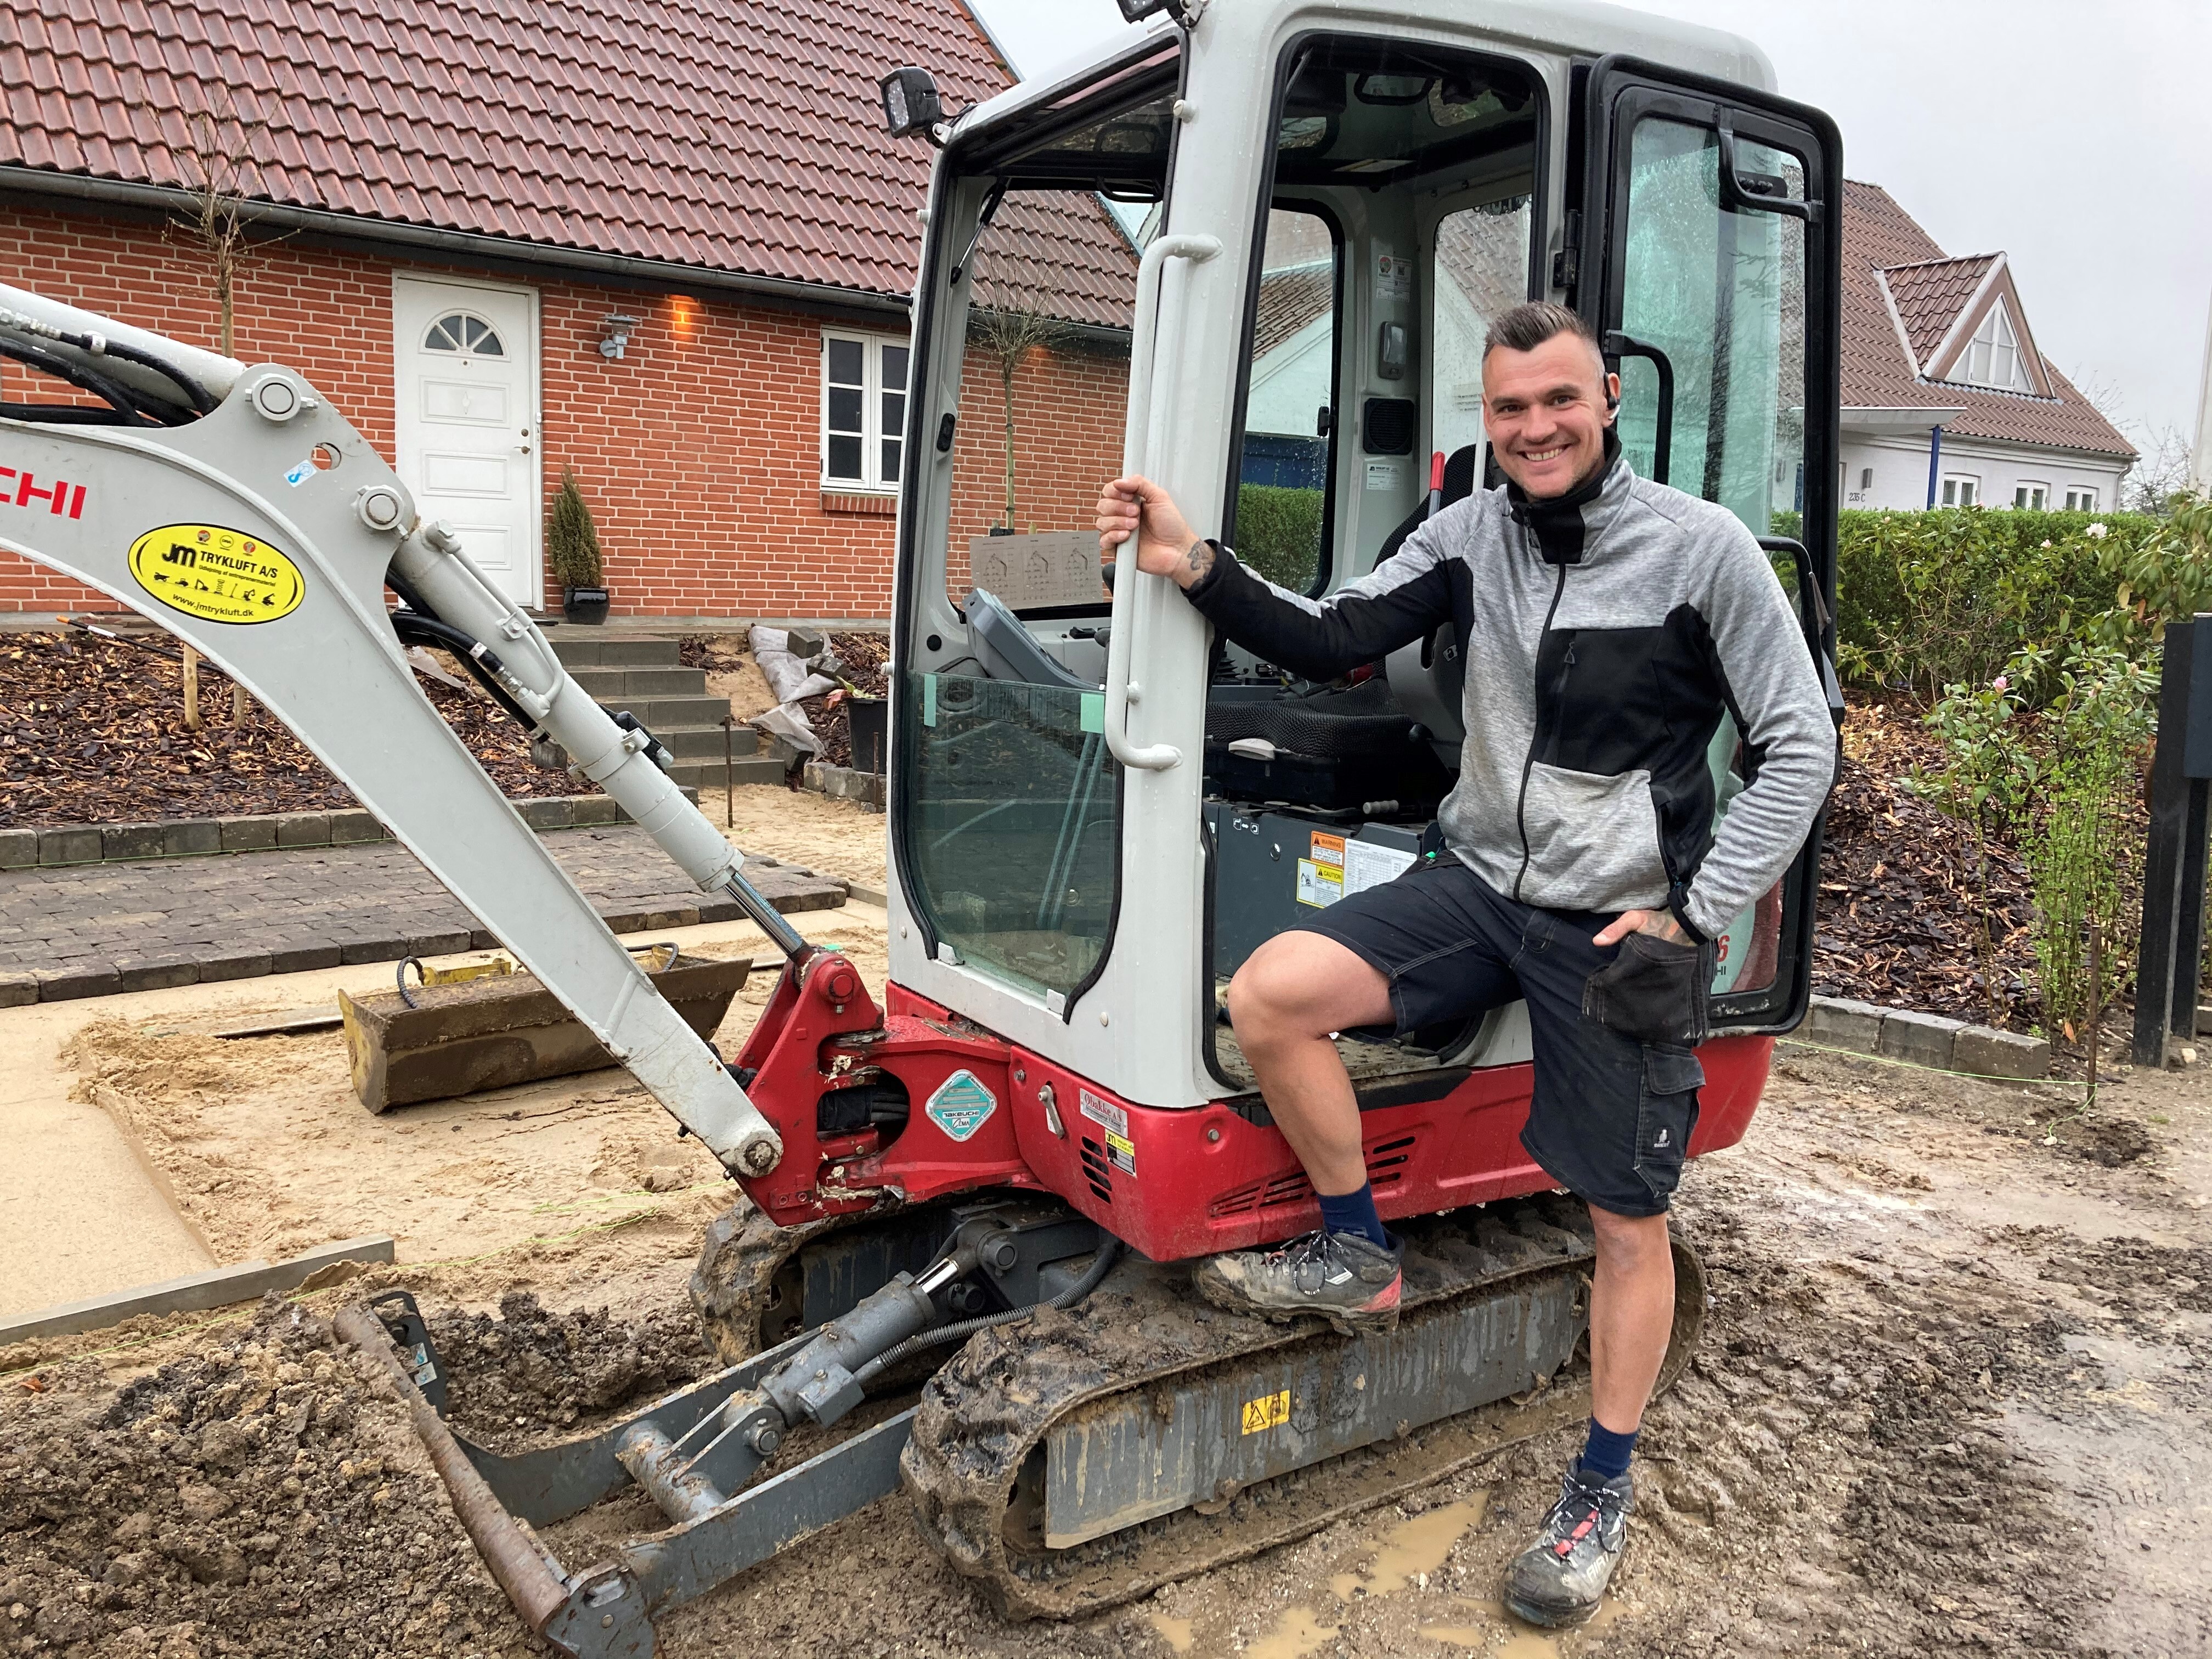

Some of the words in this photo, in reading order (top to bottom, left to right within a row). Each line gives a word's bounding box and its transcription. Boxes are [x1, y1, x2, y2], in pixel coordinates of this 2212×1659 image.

[200, 551, 257, 573] TRYKLUFT
[259, 566, 278, 578] A/S
[173, 594, 254, 617] www.jmtrykluft.dk
[1321, 839, 1341, 848] WARNING
[1323, 871, 1341, 879] CAUTION
[1085, 1093, 1111, 1115] Øbakke
[1113, 1111, 1122, 1122] A/S
